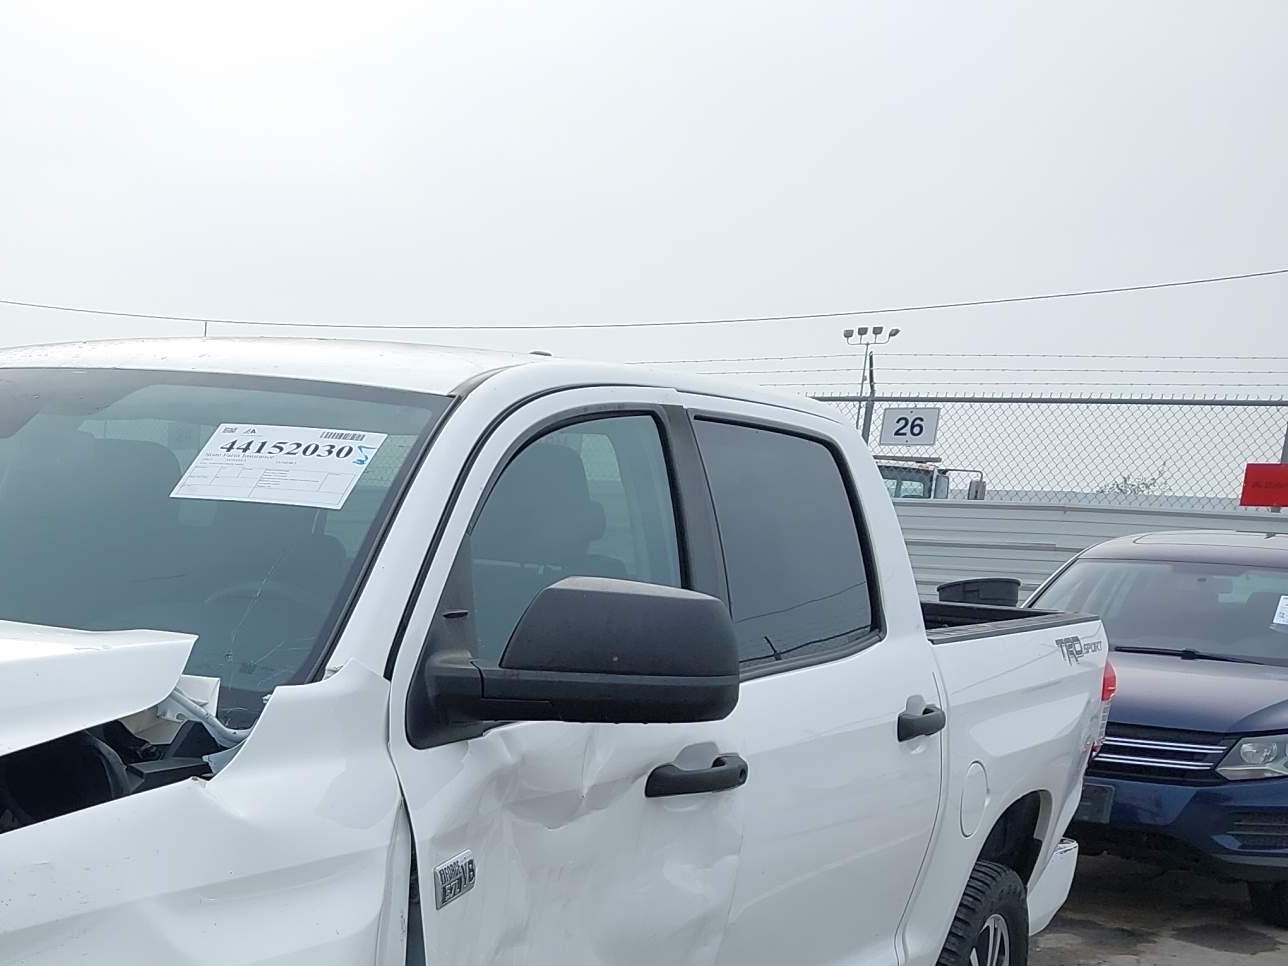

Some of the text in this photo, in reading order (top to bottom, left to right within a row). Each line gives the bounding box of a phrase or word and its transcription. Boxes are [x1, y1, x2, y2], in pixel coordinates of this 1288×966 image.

[893, 416, 925, 437] 26
[219, 439, 354, 459] 44152030
[1055, 635, 1102, 666] TRD SPORT
